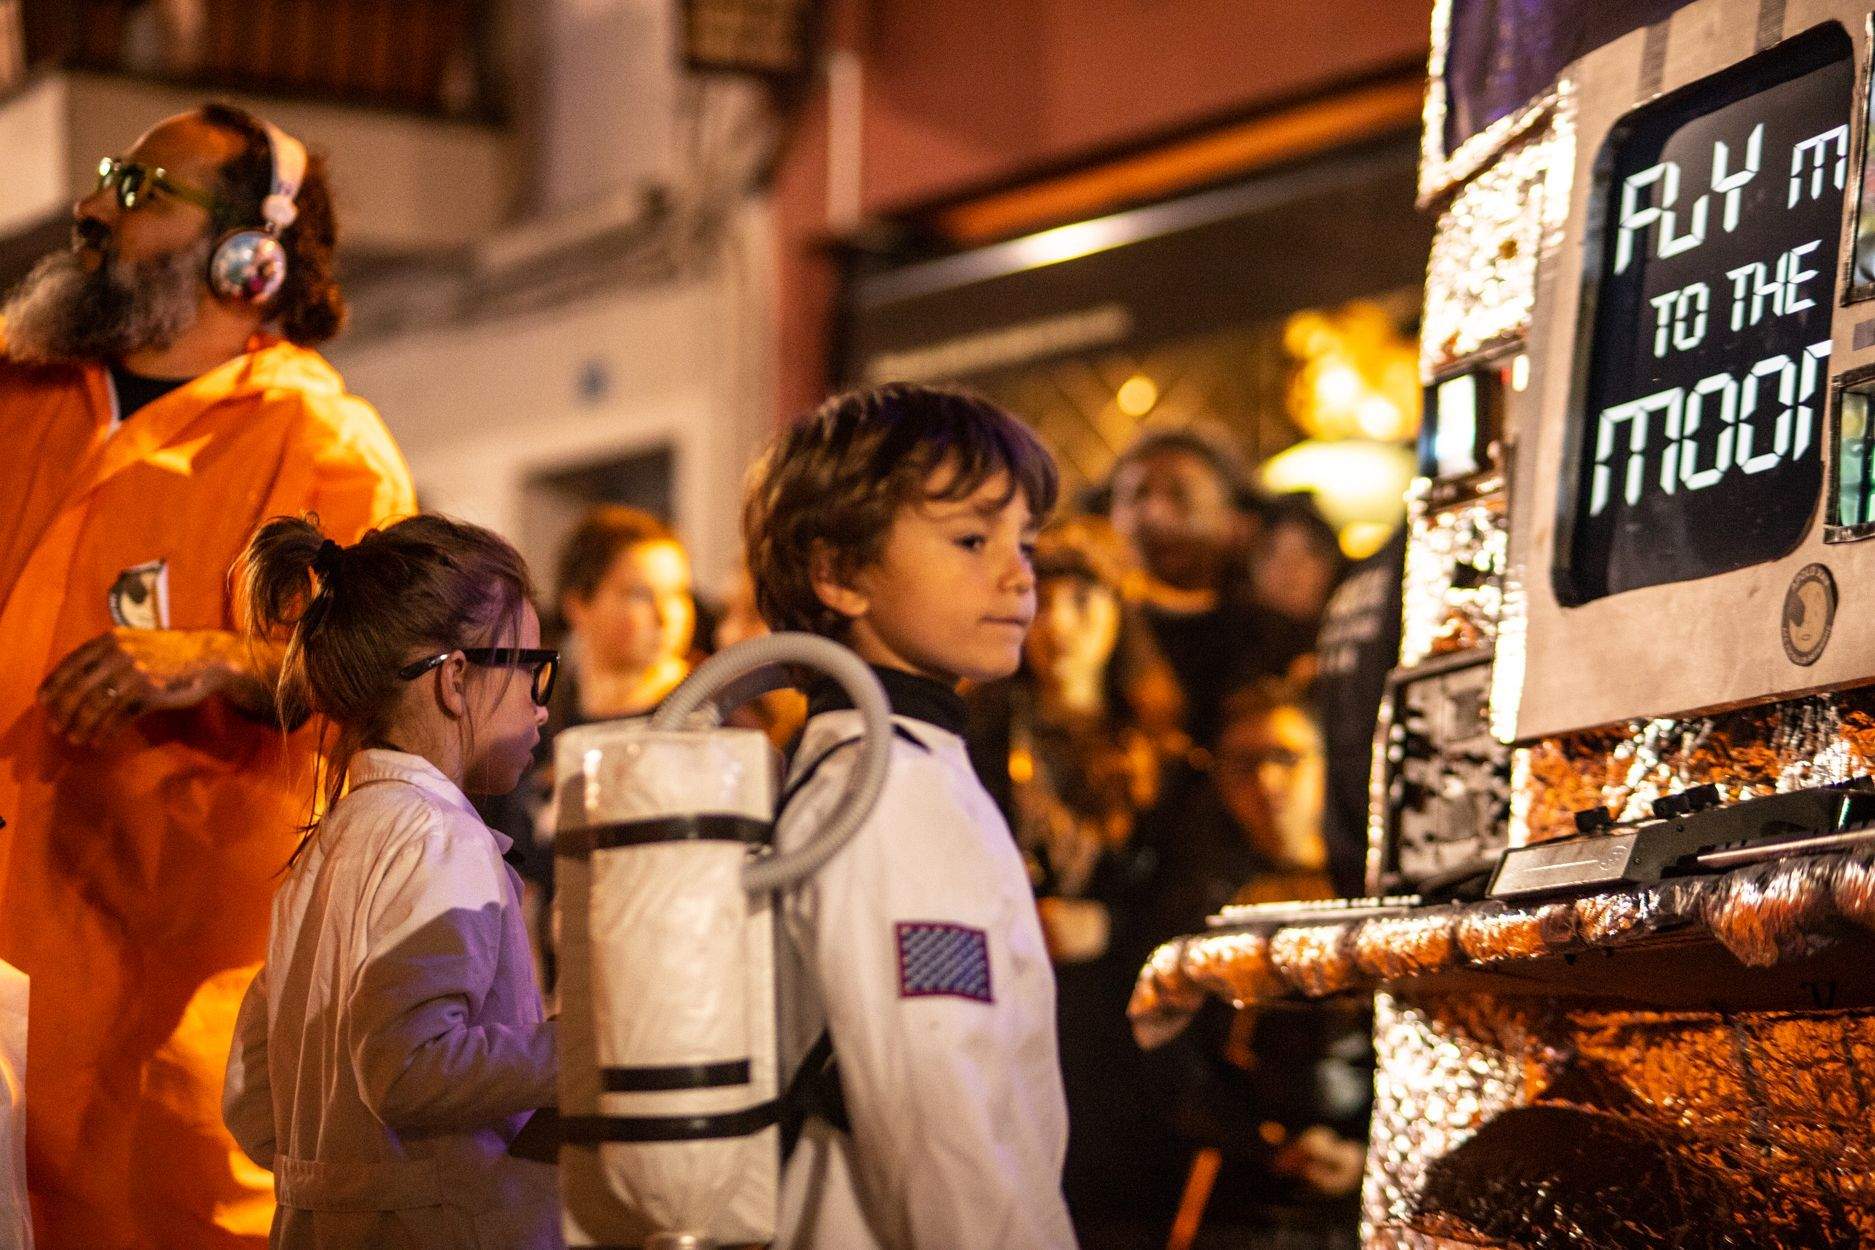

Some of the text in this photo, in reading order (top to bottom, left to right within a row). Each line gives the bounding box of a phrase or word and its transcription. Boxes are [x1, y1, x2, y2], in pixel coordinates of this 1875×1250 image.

[1614, 122, 1764, 275] FLY
[1650, 239, 1823, 358] TO THE
